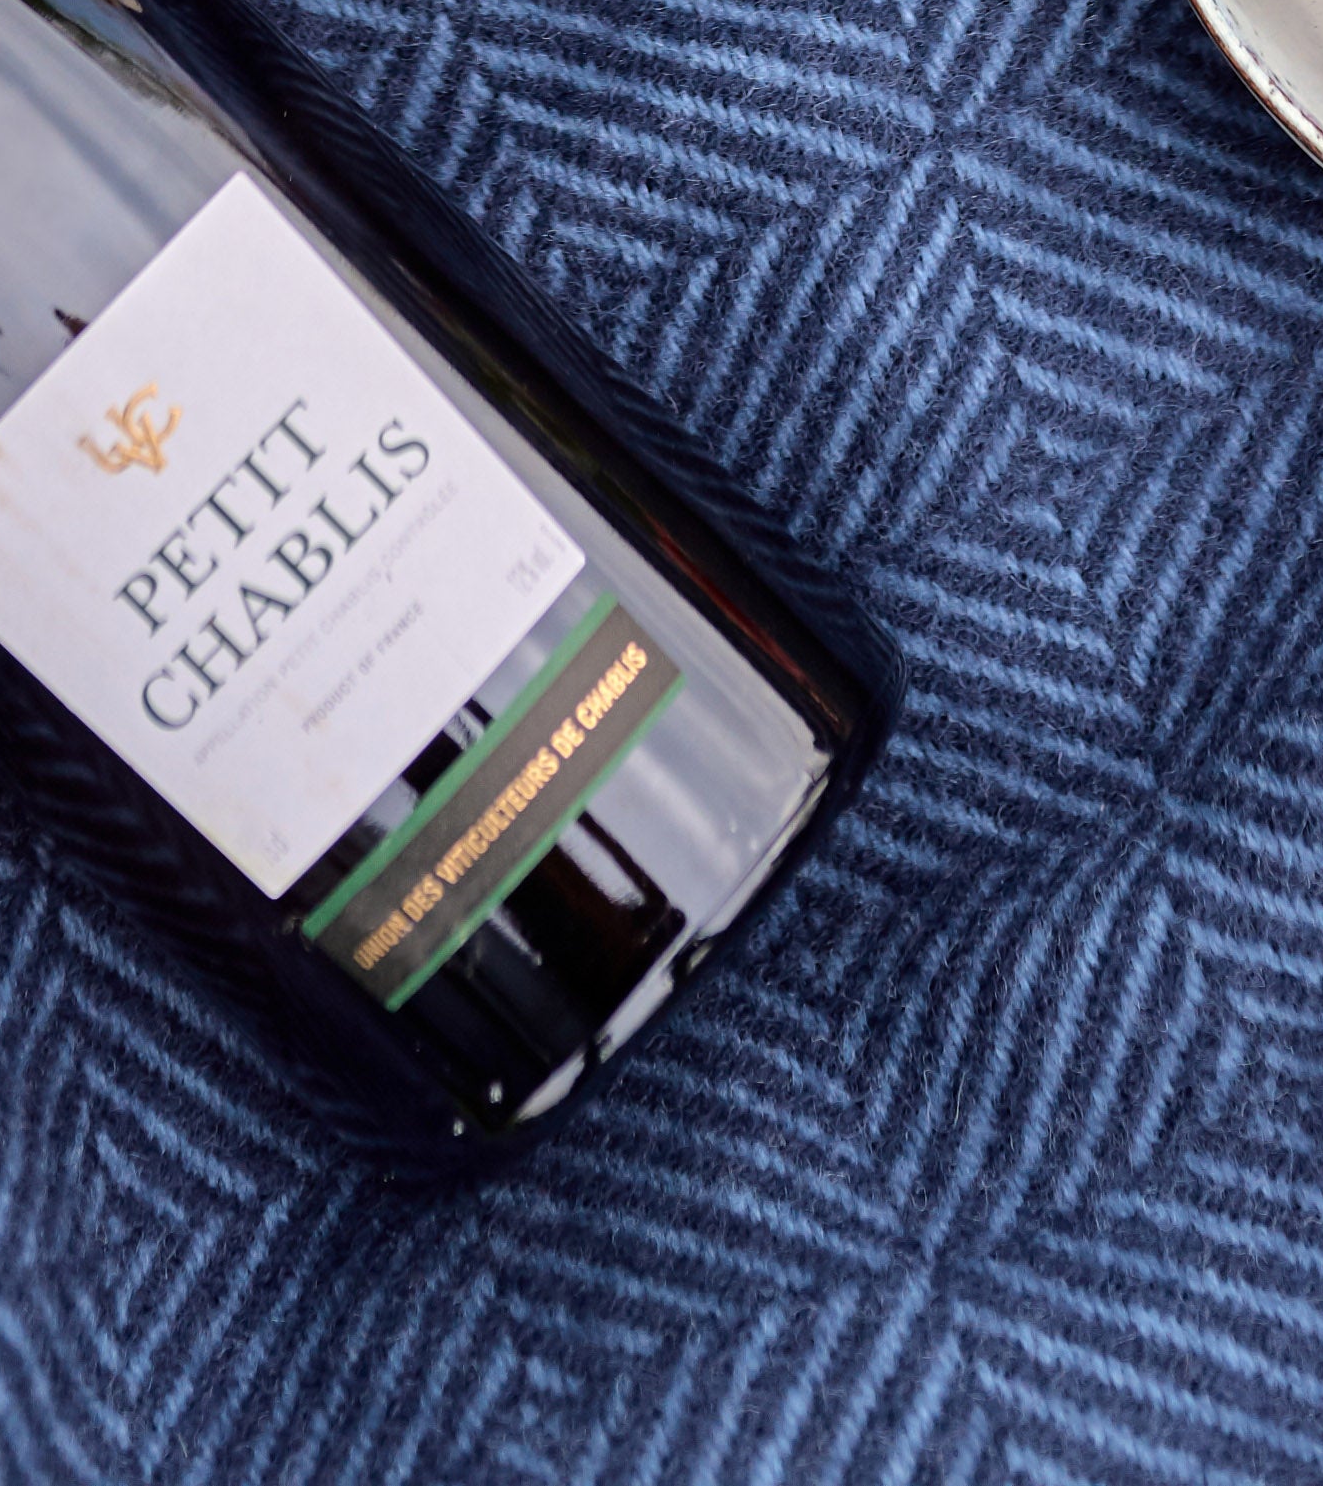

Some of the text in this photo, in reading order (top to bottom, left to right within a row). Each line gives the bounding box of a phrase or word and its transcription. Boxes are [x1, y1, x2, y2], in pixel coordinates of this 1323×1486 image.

[115, 396, 327, 636] PETIT
[140, 417, 431, 730] CHABLIS
[352, 640, 649, 971] UNION DES VITICULTEURS DE CHABLIS
